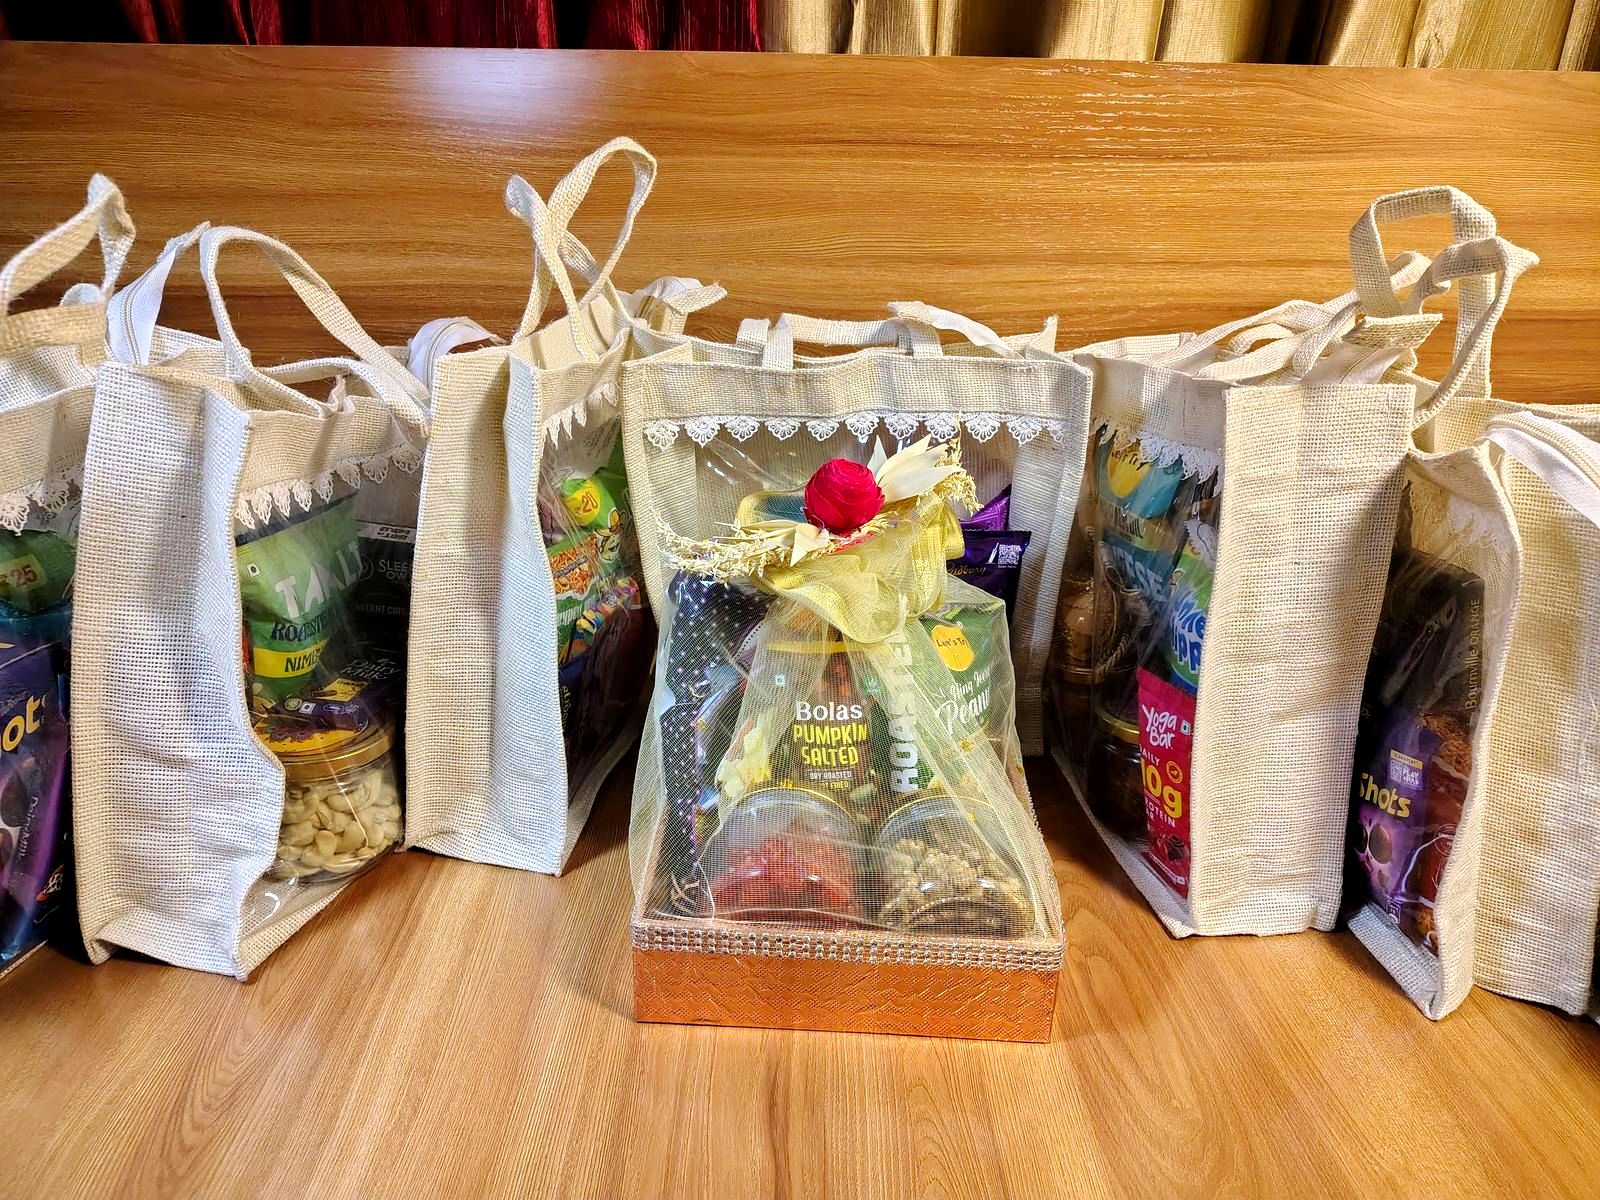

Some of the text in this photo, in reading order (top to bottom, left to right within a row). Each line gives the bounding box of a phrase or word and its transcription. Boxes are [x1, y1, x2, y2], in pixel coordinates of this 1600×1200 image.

[10, 564, 38, 588] 25
[378, 560, 410, 573] SLEE
[386, 570, 409, 580] OW
[1464, 599, 1481, 710] Bournville ORANGE
[795, 700, 863, 721] Bolas
[885, 628, 919, 794] ROASTE
[935, 687, 991, 736] Peanu
[1141, 703, 1178, 734] Yoga
[793, 722, 868, 746] PUMPKIN
[1149, 725, 1175, 750] Bar
[801, 746, 859, 768] SALTED
[1145, 796, 1176, 828] ROTEIN
